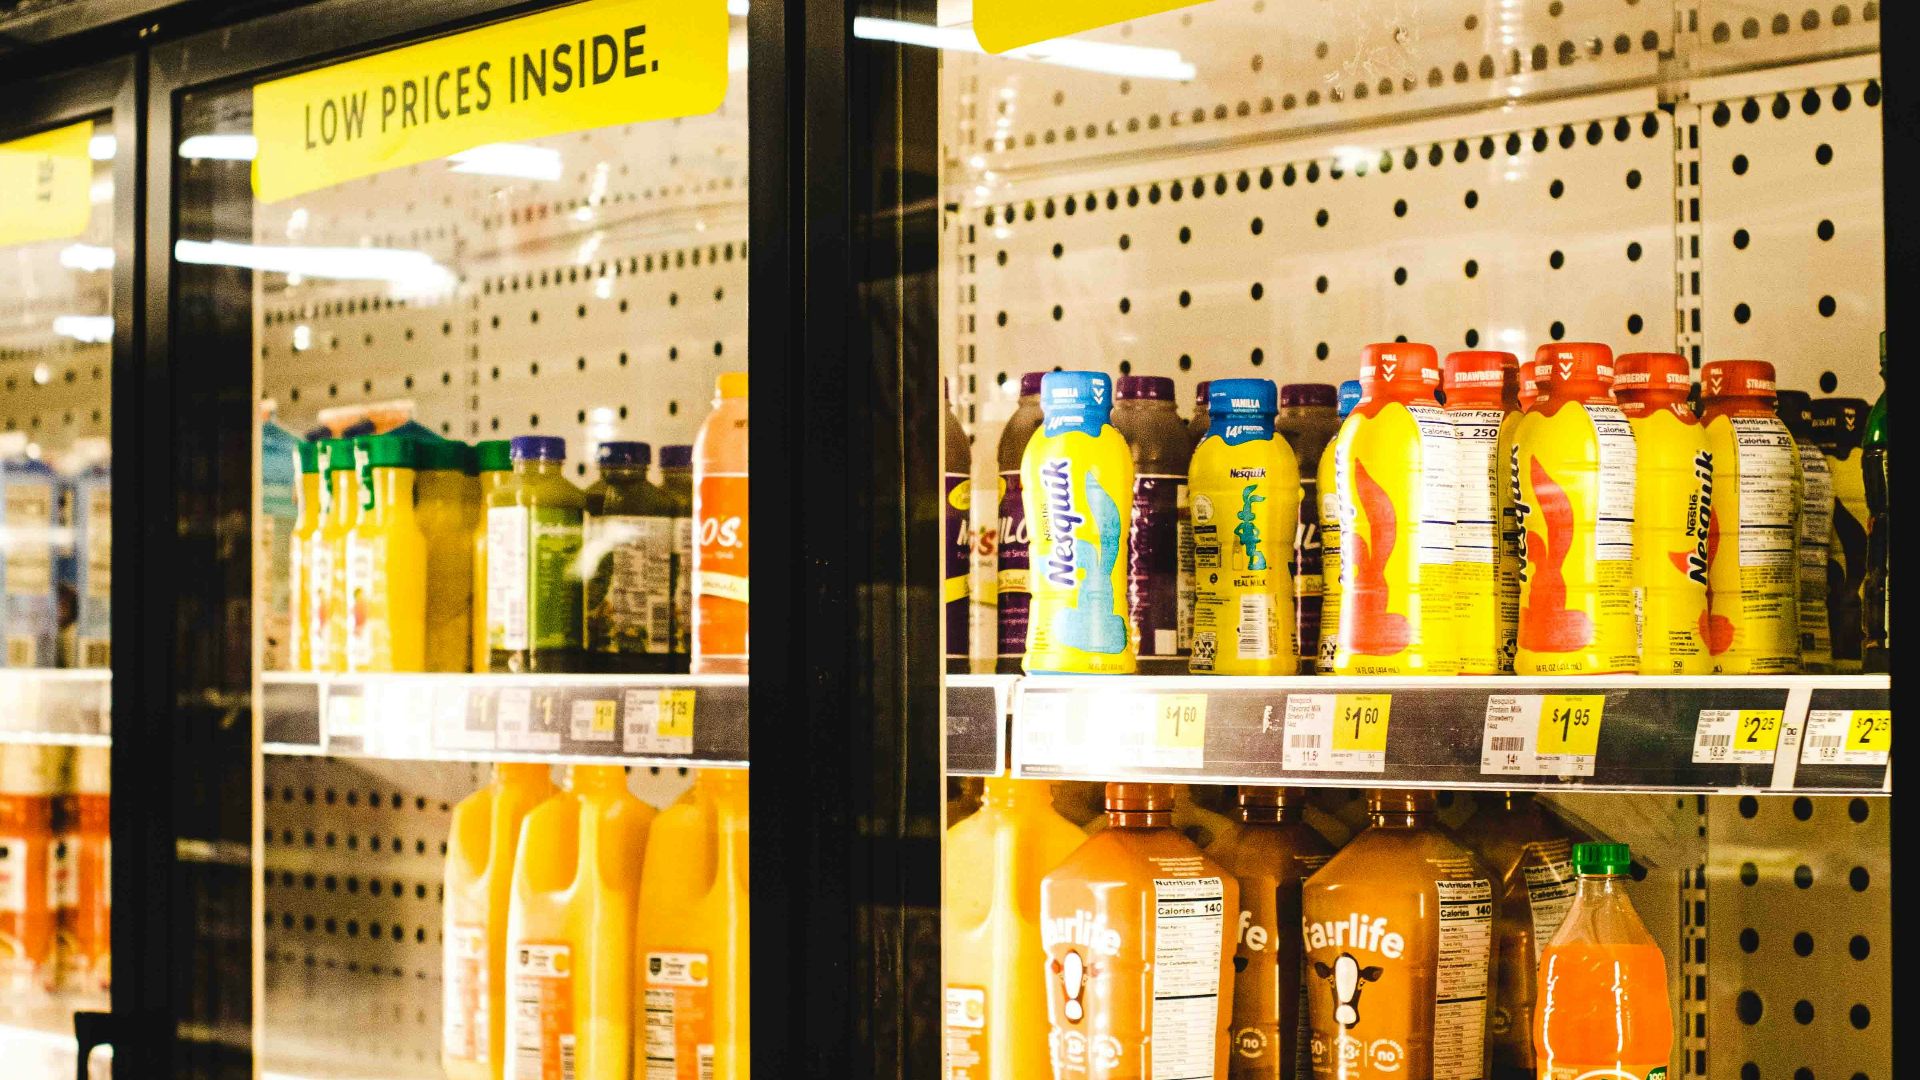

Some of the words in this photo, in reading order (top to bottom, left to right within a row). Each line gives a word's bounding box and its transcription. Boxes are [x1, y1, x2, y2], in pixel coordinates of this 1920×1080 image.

[305, 90, 367, 150] LOW
[381, 61, 492, 133] PRICES
[510, 24, 659, 104] INSIDE.
[1231, 398, 1260, 409] VANILLA
[1421, 427, 1451, 436] Calories
[1473, 429, 1498, 437] 250
[1597, 426, 1627, 434] Calories
[1230, 467, 1267, 481] Nesquik
[1042, 461, 1082, 586] Nesquik
[1487, 715, 1514, 723] Strawberry
[1158, 907, 1196, 915] Calories
[1205, 903, 1221, 912] 140
[1440, 910, 1470, 918] Calories
[1476, 905, 1491, 915] 140
[1243, 1037, 1259, 1049] no
[1377, 1051, 1396, 1063] no
